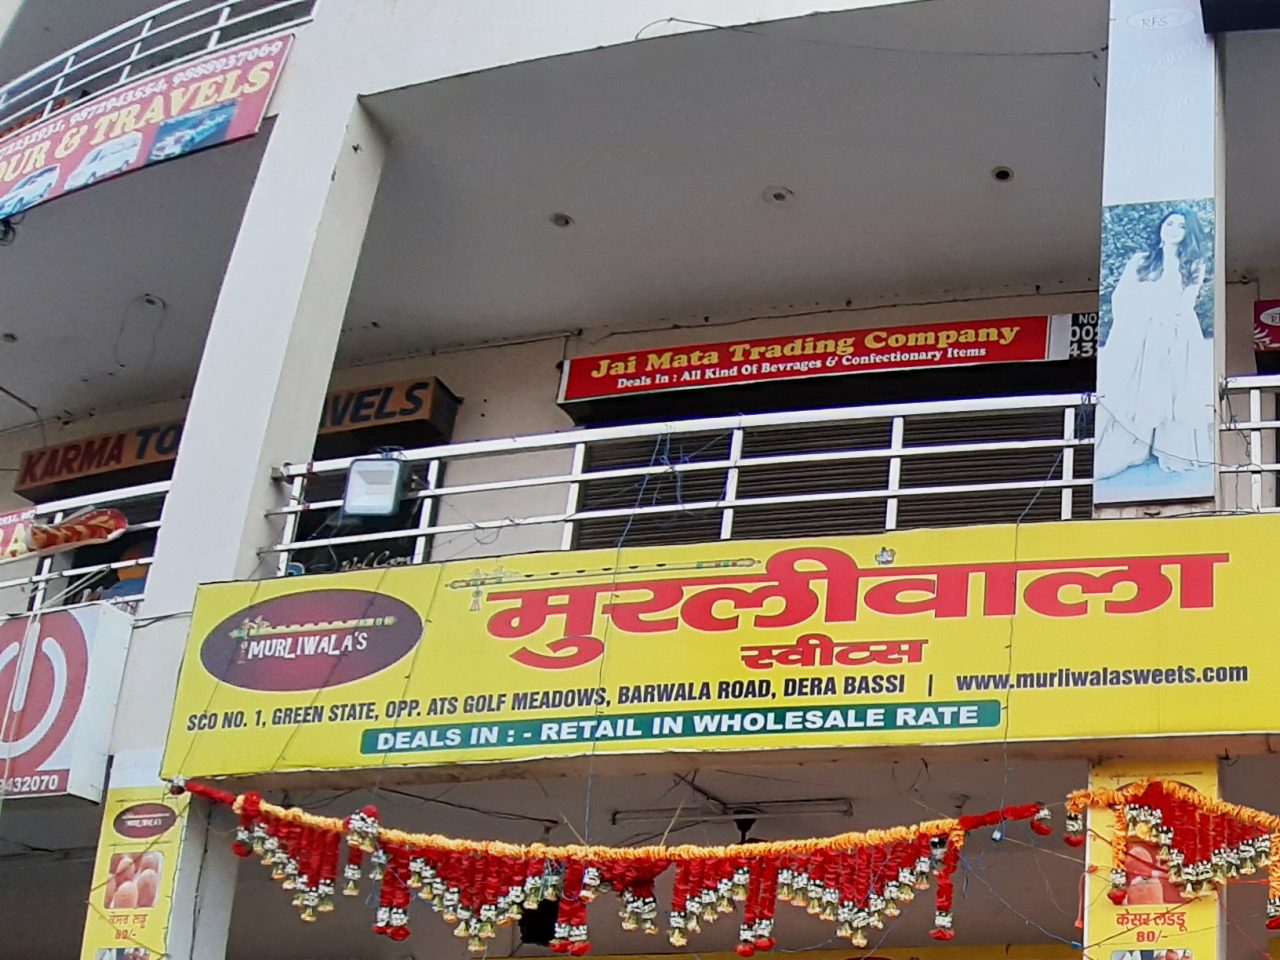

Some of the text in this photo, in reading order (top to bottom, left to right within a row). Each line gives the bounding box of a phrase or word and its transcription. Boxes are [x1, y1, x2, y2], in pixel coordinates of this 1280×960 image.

[90, 60, 275, 145] TRAVELS
[591, 323, 1021, 379] Jai Mata Trading Company
[1070, 325, 1099, 342] 00
[1070, 342, 1099, 357] 43
[617, 374, 652, 389] Deals
[655, 373, 670, 384] In
[681, 369, 702, 382] All
[704, 365, 739, 380] Kind
[740, 362, 759, 376] Of
[761, 357, 822, 375] Bevrages
[825, 355, 839, 368] &
[841, 348, 944, 368] Confectionary
[946, 343, 987, 359] Items
[20, 433, 126, 486] KARMA
[486, 547, 1229, 670] मुरलीवाला
[248, 631, 368, 660] MURLIWALA'S
[187, 712, 219, 730] SCO
[222, 711, 250, 729] NO.
[254, 709, 267, 728] 1,
[271, 705, 324, 726] GREEN
[328, 703, 380, 724] STATE,
[385, 698, 422, 719] OPP.
[426, 696, 458, 717] ATS
[463, 694, 507, 714] GOLF
[511, 688, 611, 712] MEADOWS,
[617, 682, 713, 706] BARWALA
[717, 680, 777, 701] ROAD,
[782, 677, 836, 698] DERA
[842, 675, 906, 695] BASSI
[956, 664, 1249, 692] www.murliwalasweets.com
[376, 726, 461, 750] DEALS
[468, 724, 497, 747] IN
[540, 716, 643, 743] RETAIL
[650, 715, 687, 737] IN
[692, 707, 886, 734] WHOLESALE
[894, 704, 980, 726] RATE
[1136, 930, 1168, 943] 80/-
